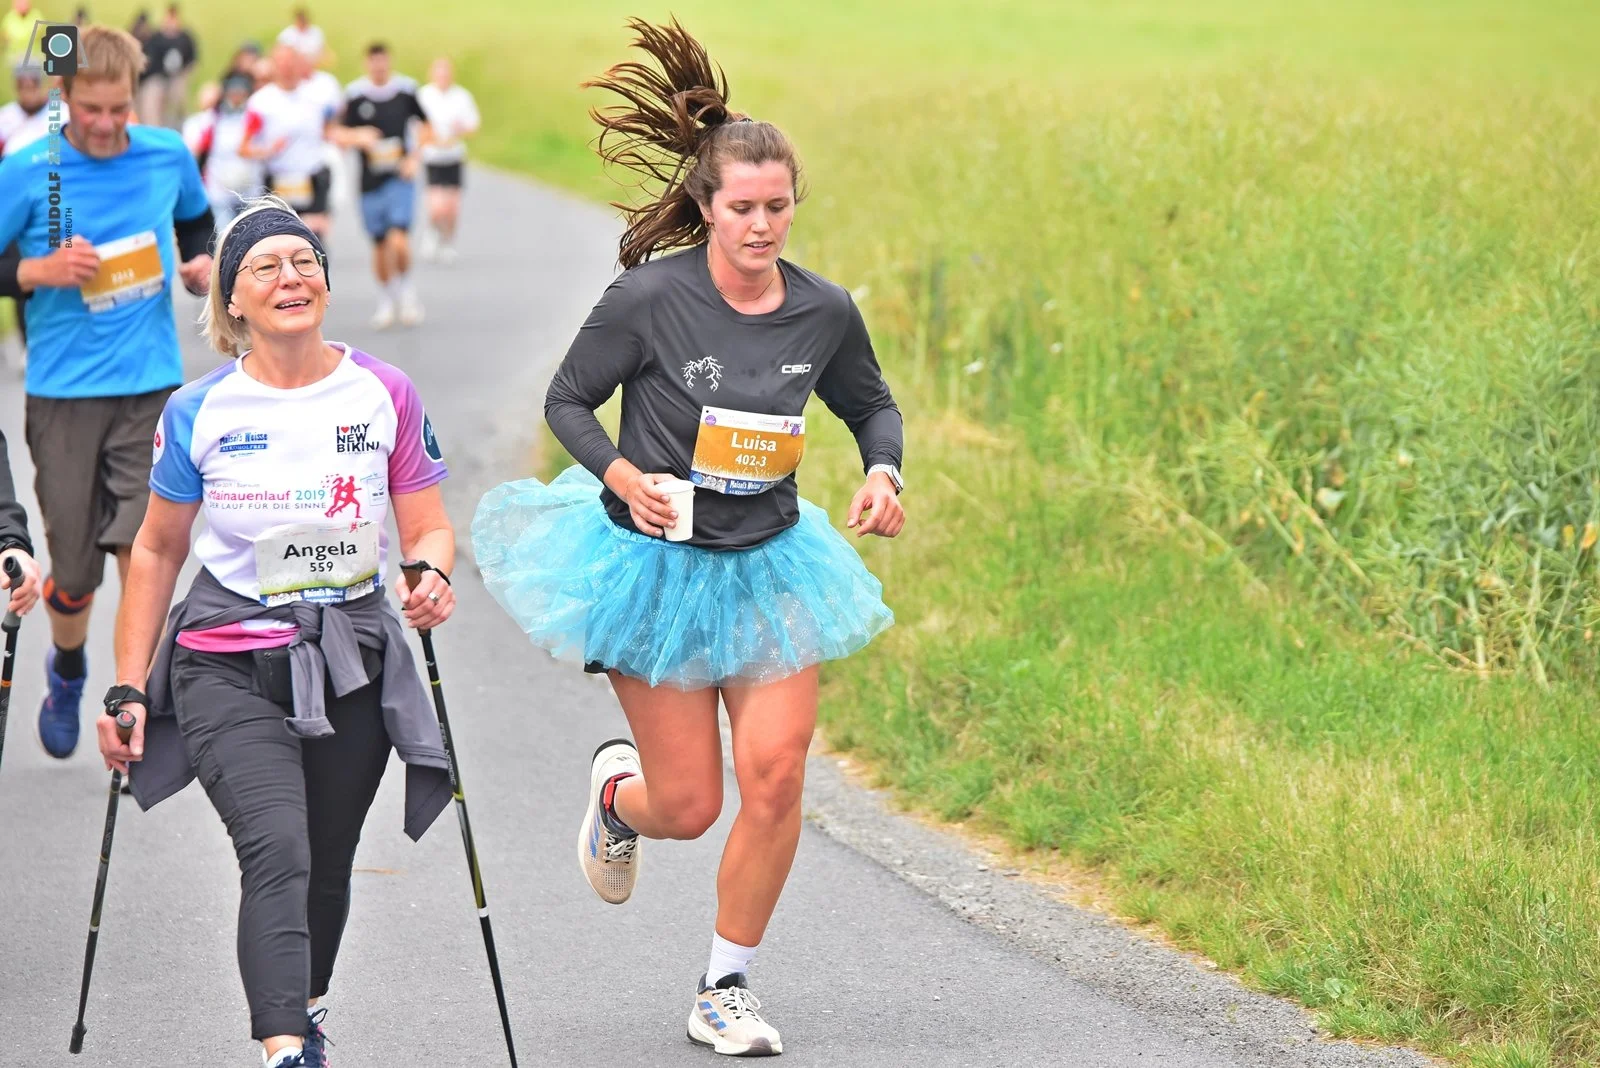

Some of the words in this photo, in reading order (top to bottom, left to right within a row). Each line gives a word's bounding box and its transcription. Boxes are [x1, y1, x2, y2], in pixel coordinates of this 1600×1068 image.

[350, 423, 370, 434] MY
[336, 432, 367, 443] NEW
[731, 431, 777, 452] Luisa
[336, 441, 380, 453] BIKINI
[735, 453, 767, 467] 402-3
[208, 489, 291, 501] Mainauenlauf
[295, 489, 326, 500] 2019
[221, 502, 245, 510] LAUF
[248, 500, 269, 510] FÜR
[294, 502, 327, 510] SINNE
[283, 541, 358, 561] Angela
[310, 561, 334, 572] 559
